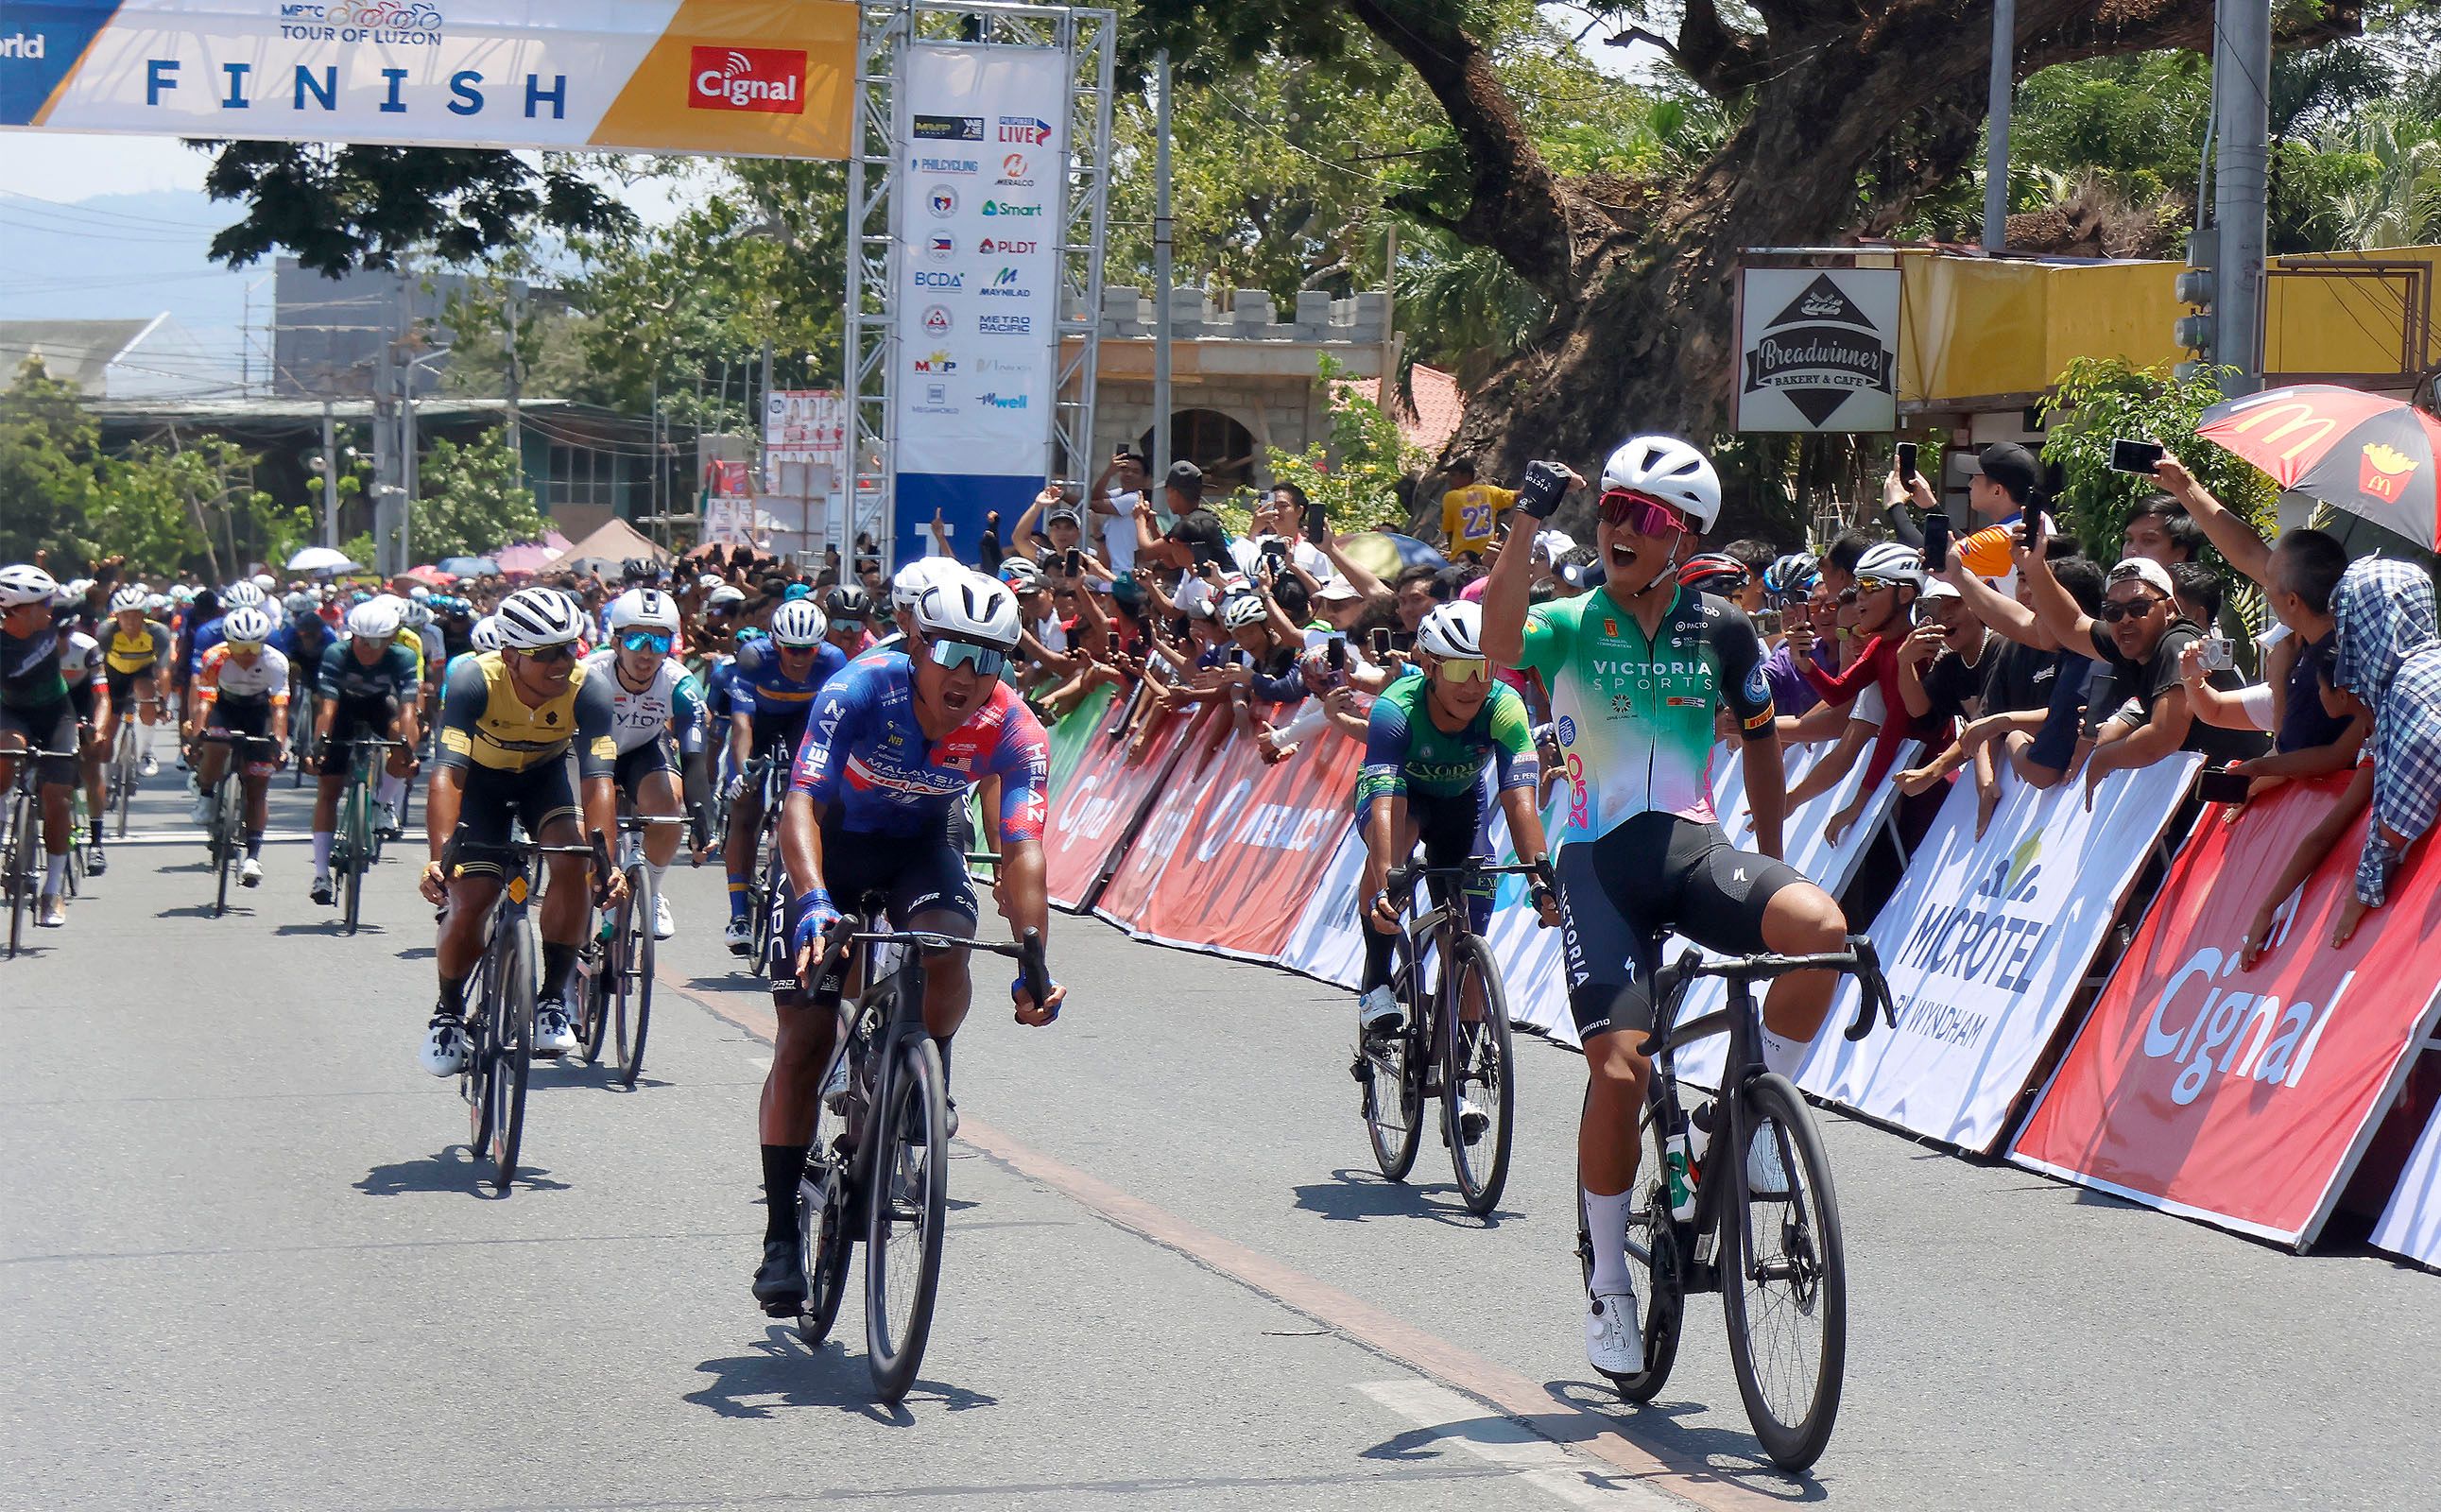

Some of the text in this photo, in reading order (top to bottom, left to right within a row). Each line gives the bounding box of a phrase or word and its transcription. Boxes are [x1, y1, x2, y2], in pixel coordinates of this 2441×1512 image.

[281, 26, 441, 45] TOUR OF LUZON
[0, 33, 44, 59] rld
[146, 59, 566, 119] FINISH
[696, 70, 797, 106] Cignal
[999, 127, 1034, 144] LIVE
[921, 159, 978, 172] PHILCYCLING
[994, 179, 1034, 187] MERALCO
[1000, 203, 1041, 216] Smart
[998, 241, 1037, 254] PLDT
[915, 271, 962, 287] BCDA
[979, 288, 1030, 298] MAYNILAD
[979, 315, 1030, 324] METRO
[979, 323, 1030, 333] PACIFIC
[1760, 338, 1880, 370] Breadwinner
[1775, 374, 1863, 387] BAKERY & CAFE
[1461, 504, 1493, 539] 23
[1692, 603, 1720, 617] Grab
[1593, 660, 1711, 676] VICTORIA
[1593, 678, 1712, 690] SPORTS
[801, 699, 847, 780] HELAZ
[867, 757, 966, 786] MALAYSIA
[1025, 742, 1046, 823] HELAZ
[1568, 753, 1588, 829] 2GO
[1561, 883, 1590, 987] VICTORIA
[1899, 902, 2053, 994] MICROTEL
[1907, 999, 1988, 1050] WYNDHAM
[2143, 946, 2356, 1106] Cignal
